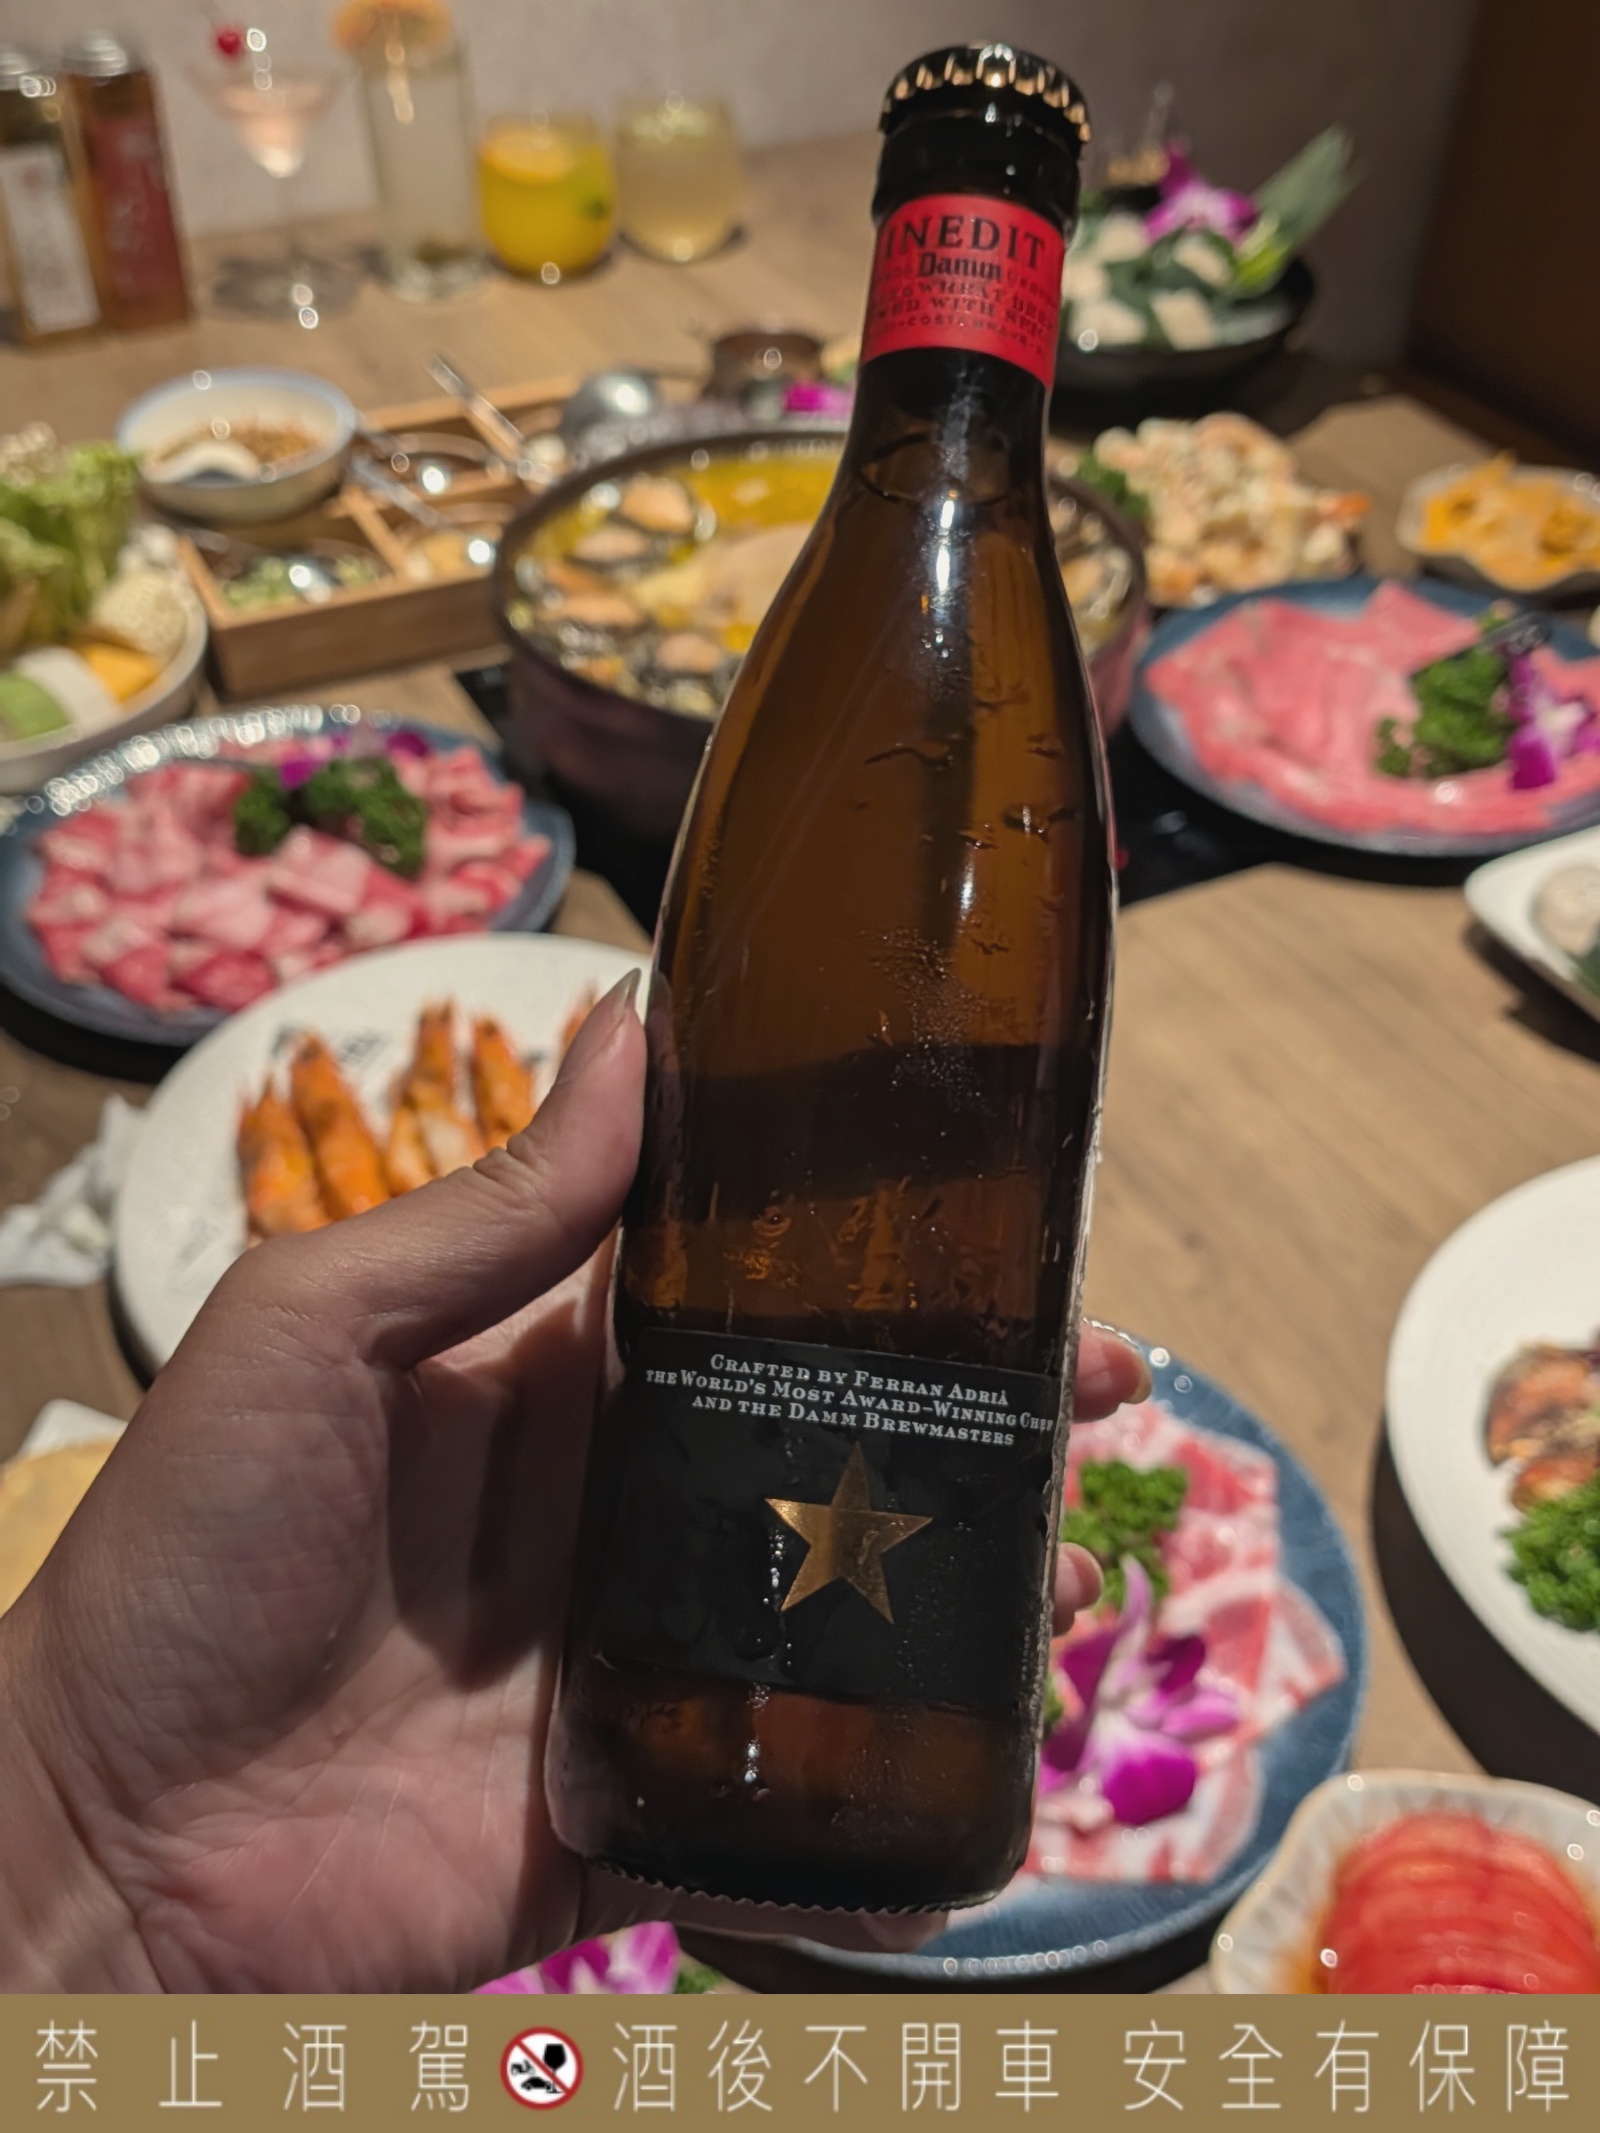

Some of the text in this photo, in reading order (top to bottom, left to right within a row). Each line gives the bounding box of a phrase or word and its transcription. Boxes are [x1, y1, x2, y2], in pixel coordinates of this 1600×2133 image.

[884, 213, 1046, 274] INEDIT
[917, 252, 1003, 285] Damm
[680, 1369, 766, 1395] WORLD'S
[772, 1380, 835, 1405] MOST
[710, 1353, 811, 1381] CRAFTED
[816, 1369, 848, 1385] BY
[853, 1369, 944, 1397] FERRAN
[692, 1396, 1015, 1446] AND THE DAMM BREWMASTERS
